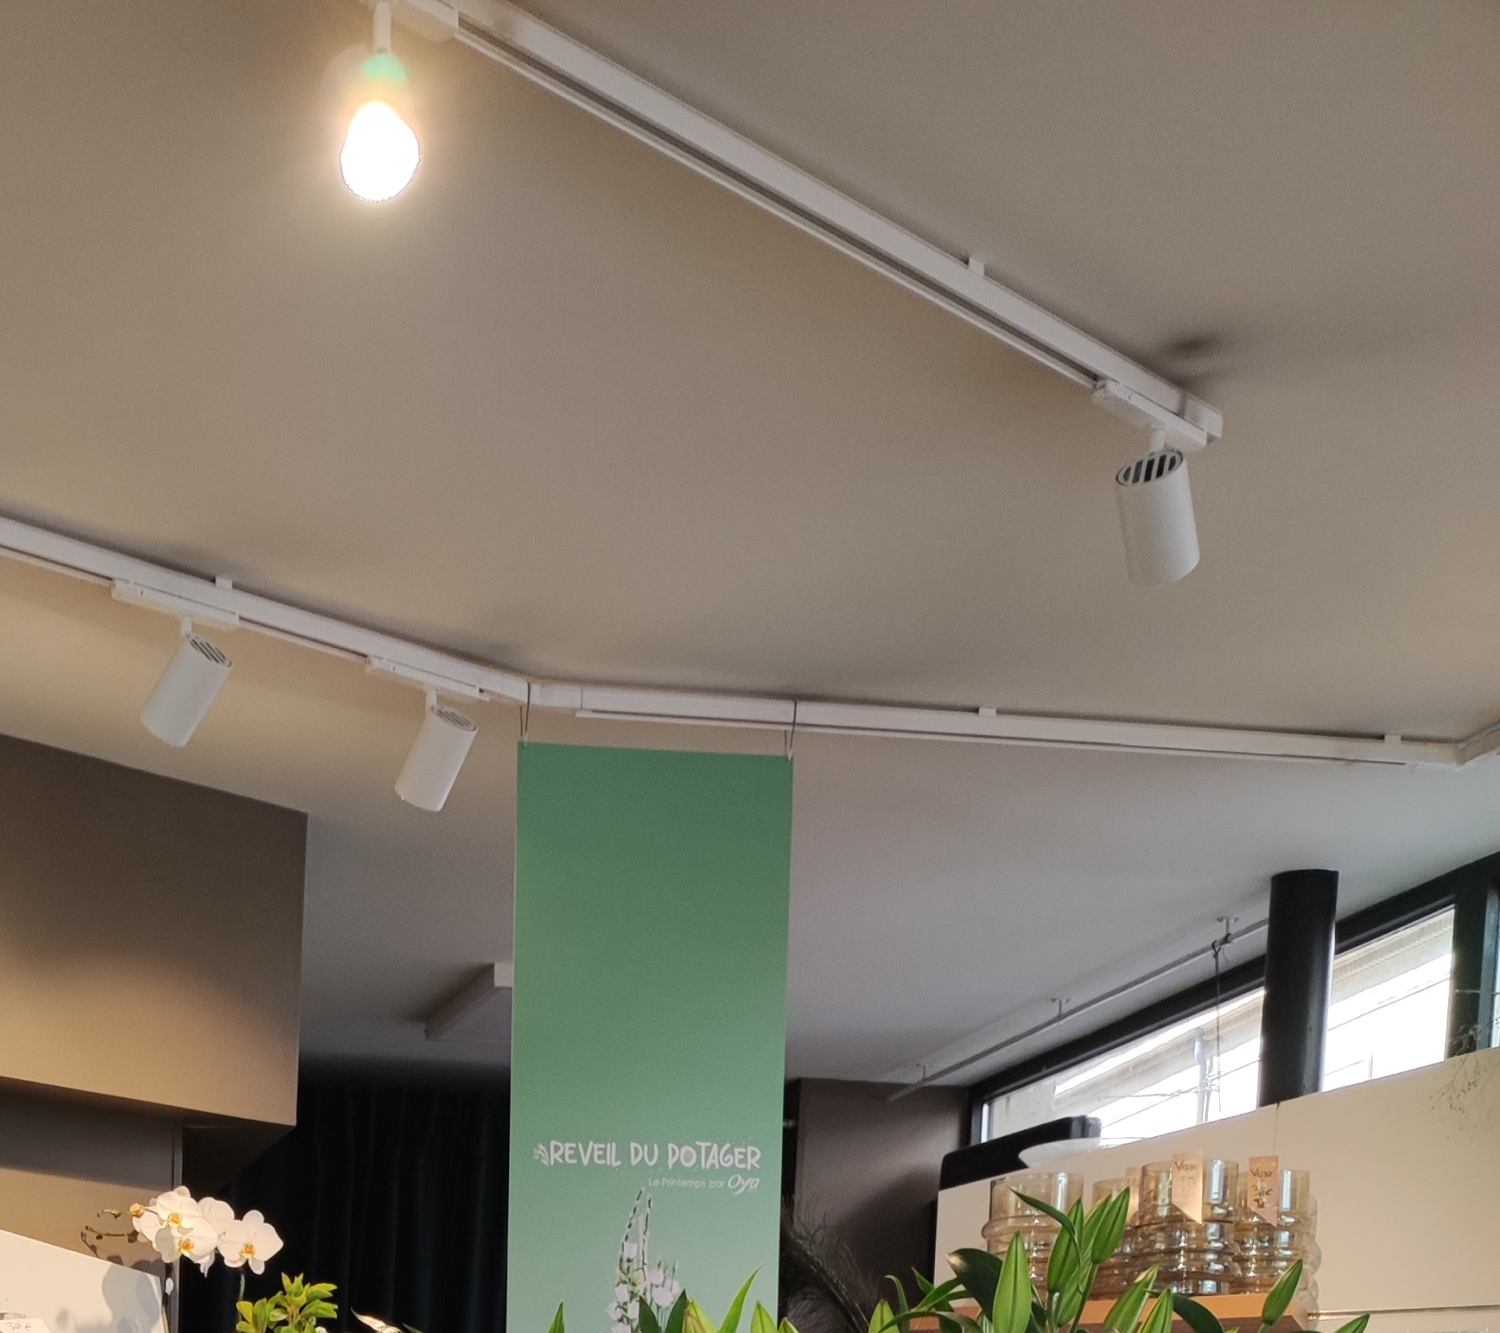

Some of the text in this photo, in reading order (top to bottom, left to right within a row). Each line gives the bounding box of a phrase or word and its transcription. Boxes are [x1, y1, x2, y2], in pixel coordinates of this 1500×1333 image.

[549, 1140, 761, 1170] REVEIL DU POTAGER
[649, 1174, 760, 1195] Le Printemps par Oya
